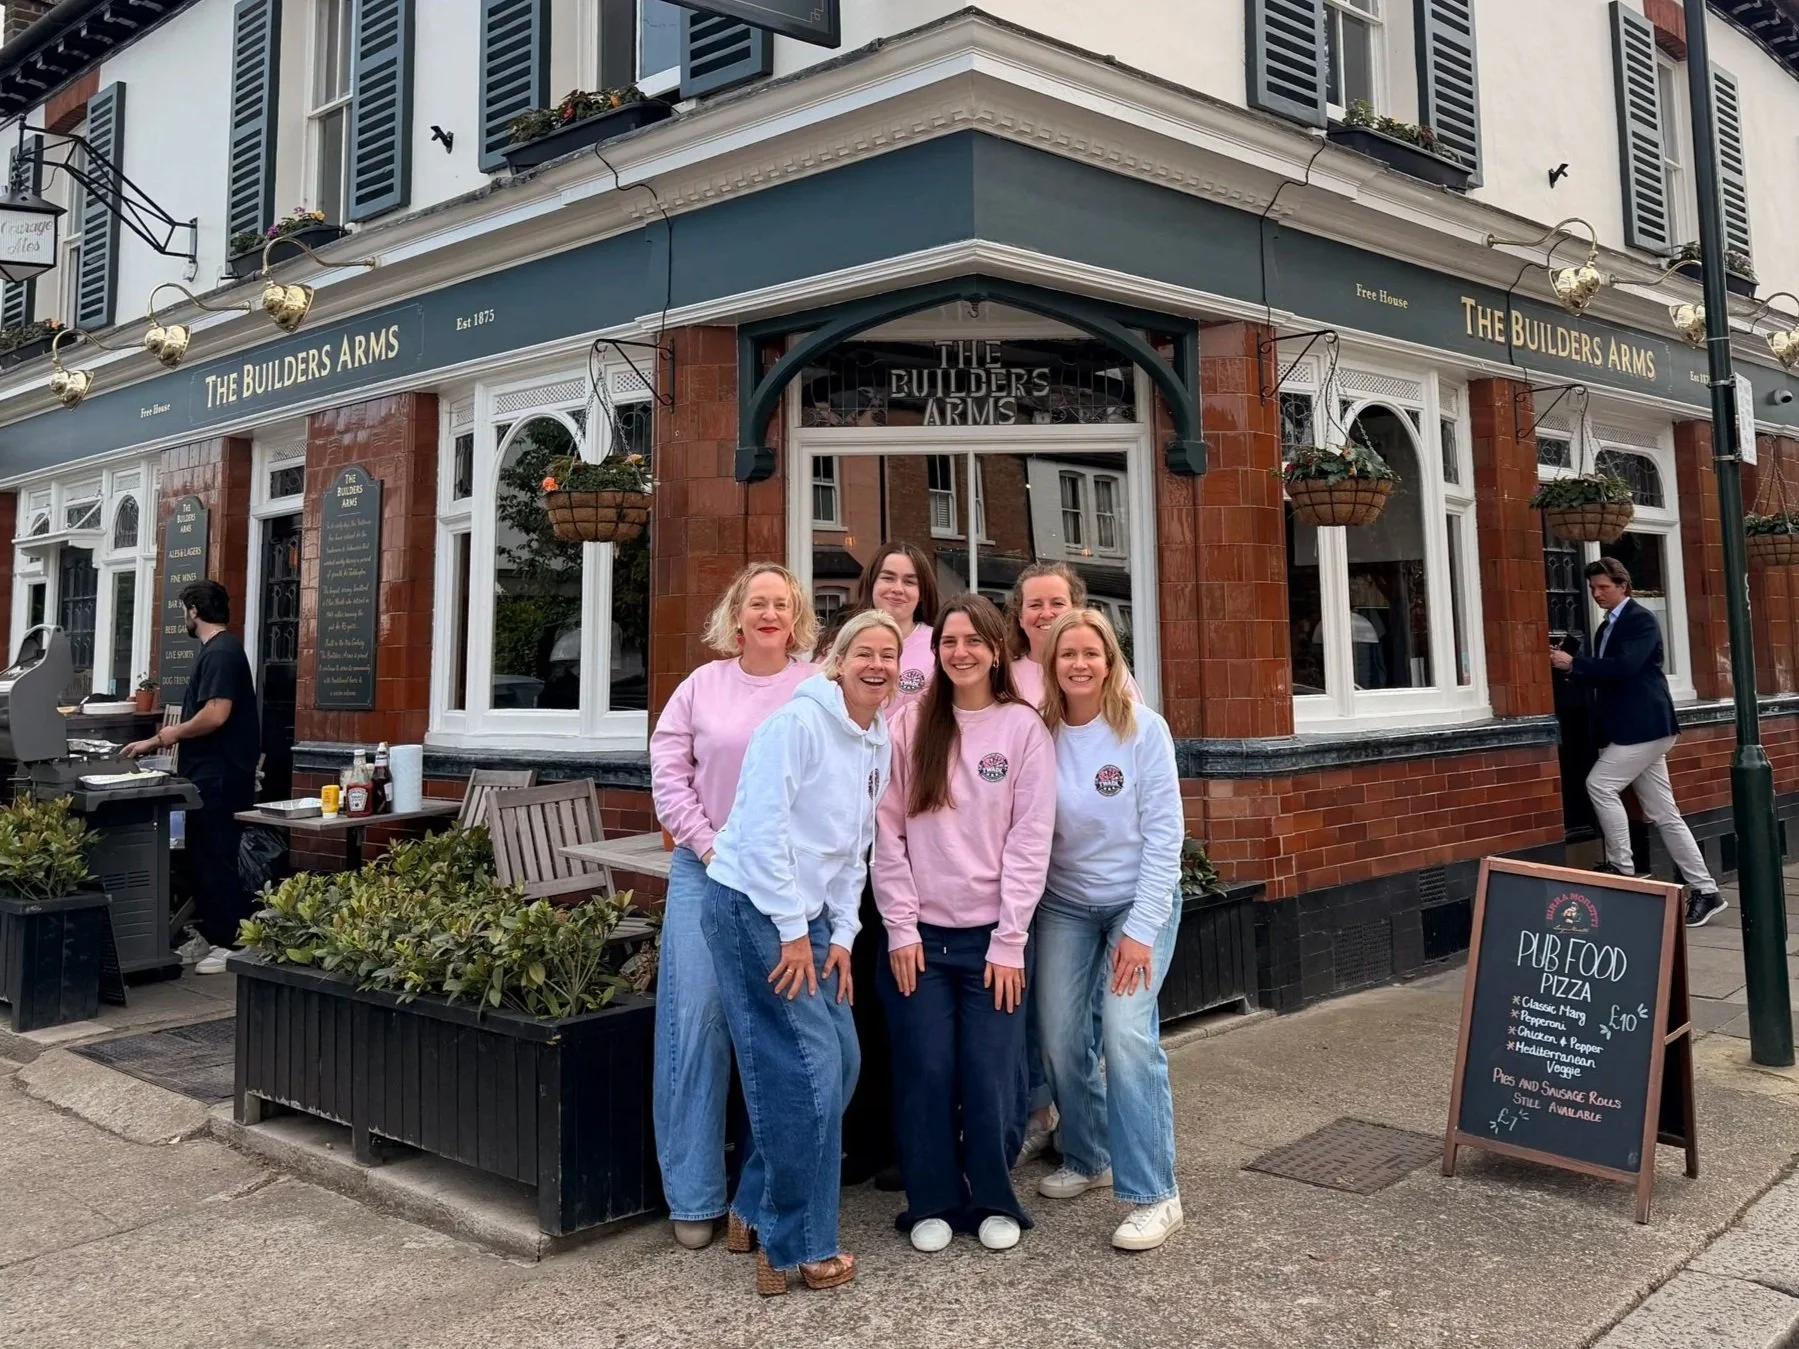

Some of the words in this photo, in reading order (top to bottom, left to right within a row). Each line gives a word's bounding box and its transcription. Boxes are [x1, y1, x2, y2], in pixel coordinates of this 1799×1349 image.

[1356, 283, 1378, 301] Free
[1379, 289, 1409, 309] House
[456, 317, 472, 331] Est
[474, 309, 495, 326] 1875
[1461, 296, 1506, 344] THE
[1511, 309, 1603, 366] BUILDERS
[1608, 336, 1656, 380] ARMS
[934, 340, 1001, 369] THE
[140, 408, 153, 419] Free
[153, 402, 171, 417] House
[205, 372, 237, 408] THE
[243, 344, 331, 398] BUILDERS
[336, 324, 400, 373] ARMS
[890, 368, 1050, 398] BUILDERS
[923, 397, 1016, 426] ARMS
[337, 484, 363, 497] BUILDERS
[345, 474, 357, 484] THE
[341, 497, 358, 509] ARMS
[176, 513, 196, 523] BUILDERS
[170, 574, 181, 583] FINE
[168, 600, 177, 609] BAR
[1517, 930, 1561, 972] PUB
[1565, 937, 1628, 982] FOOD
[1540, 972, 1592, 1002] PIZZA
[1520, 1010, 1567, 1031] Pepperoni
[1522, 996, 1557, 1015] Classic
[1559, 1004, 1586, 1026] Marg
[1608, 1004, 1638, 1032] £10
[1517, 1025, 1558, 1044] Chicken
[1570, 1036, 1604, 1054] Pepper
[1515, 1041, 1597, 1068] Mediterranean
[1546, 1060, 1582, 1080] Veggie
[1512, 1092, 1541, 1109] STILL
[1548, 1101, 1602, 1122] AVAILABLE
[1519, 1078, 1540, 1092] AND
[1540, 1081, 1587, 1103] SAUSAGE
[1589, 1091, 1622, 1109] ROLLS
[1497, 1107, 1518, 1132] £7
